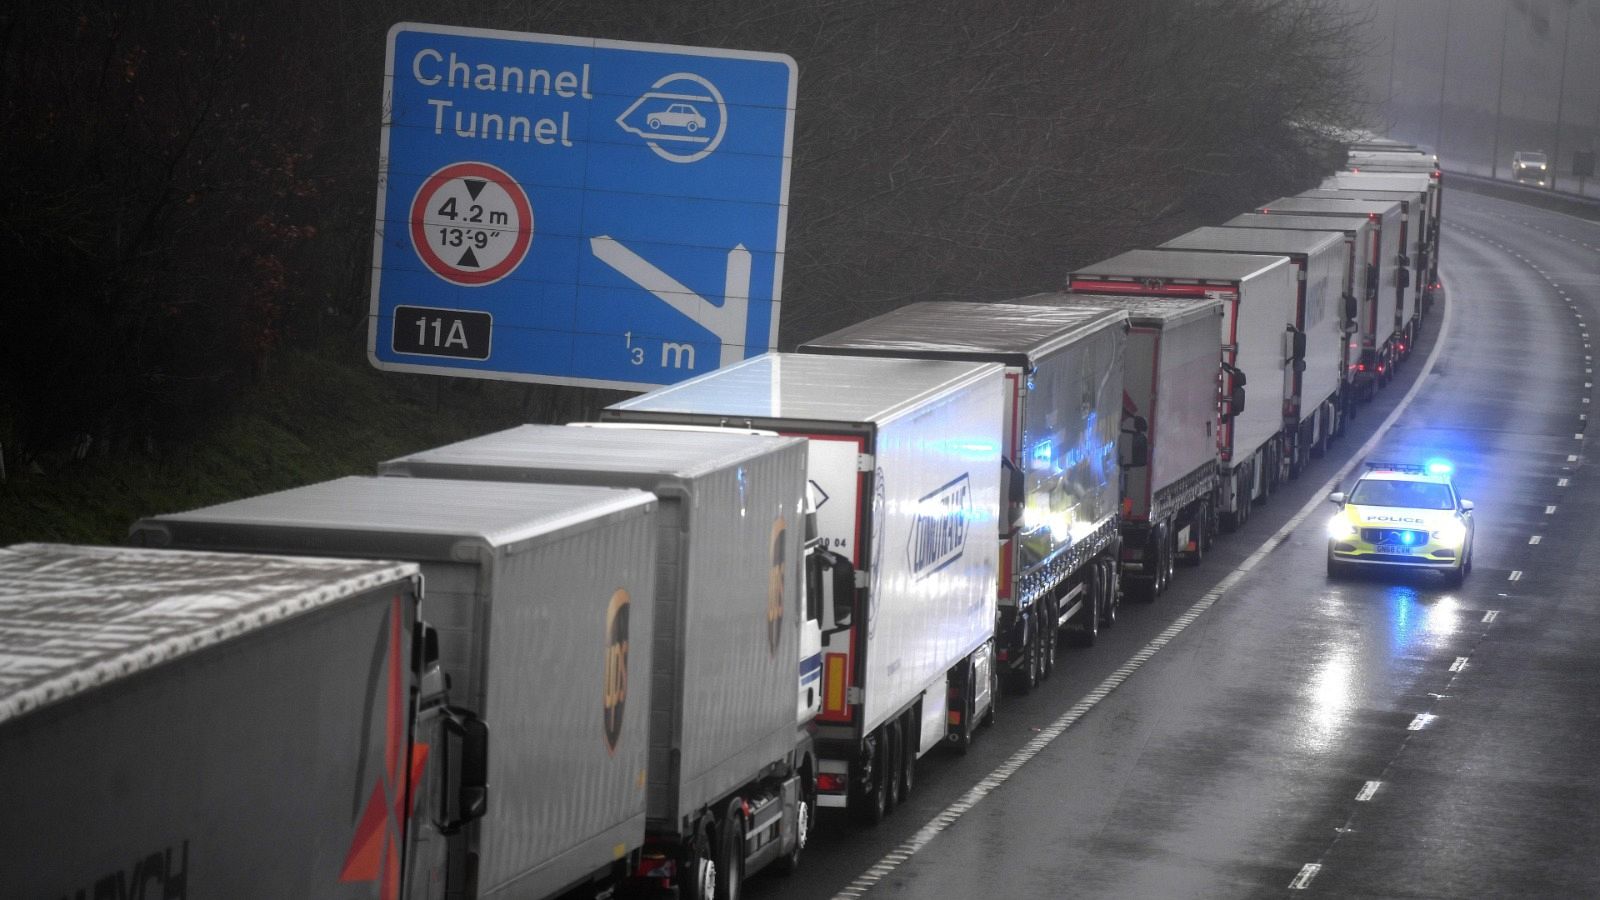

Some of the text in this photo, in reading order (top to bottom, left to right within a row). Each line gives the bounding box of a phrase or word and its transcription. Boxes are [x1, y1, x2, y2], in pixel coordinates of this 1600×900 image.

[412, 48, 593, 99] Channel
[427, 98, 573, 147] Tunnel
[438, 197, 508, 225] 4.2 m
[416, 316, 468, 349] 11A
[661, 342, 695, 369] m
[1367, 515, 1424, 524] POLICE
